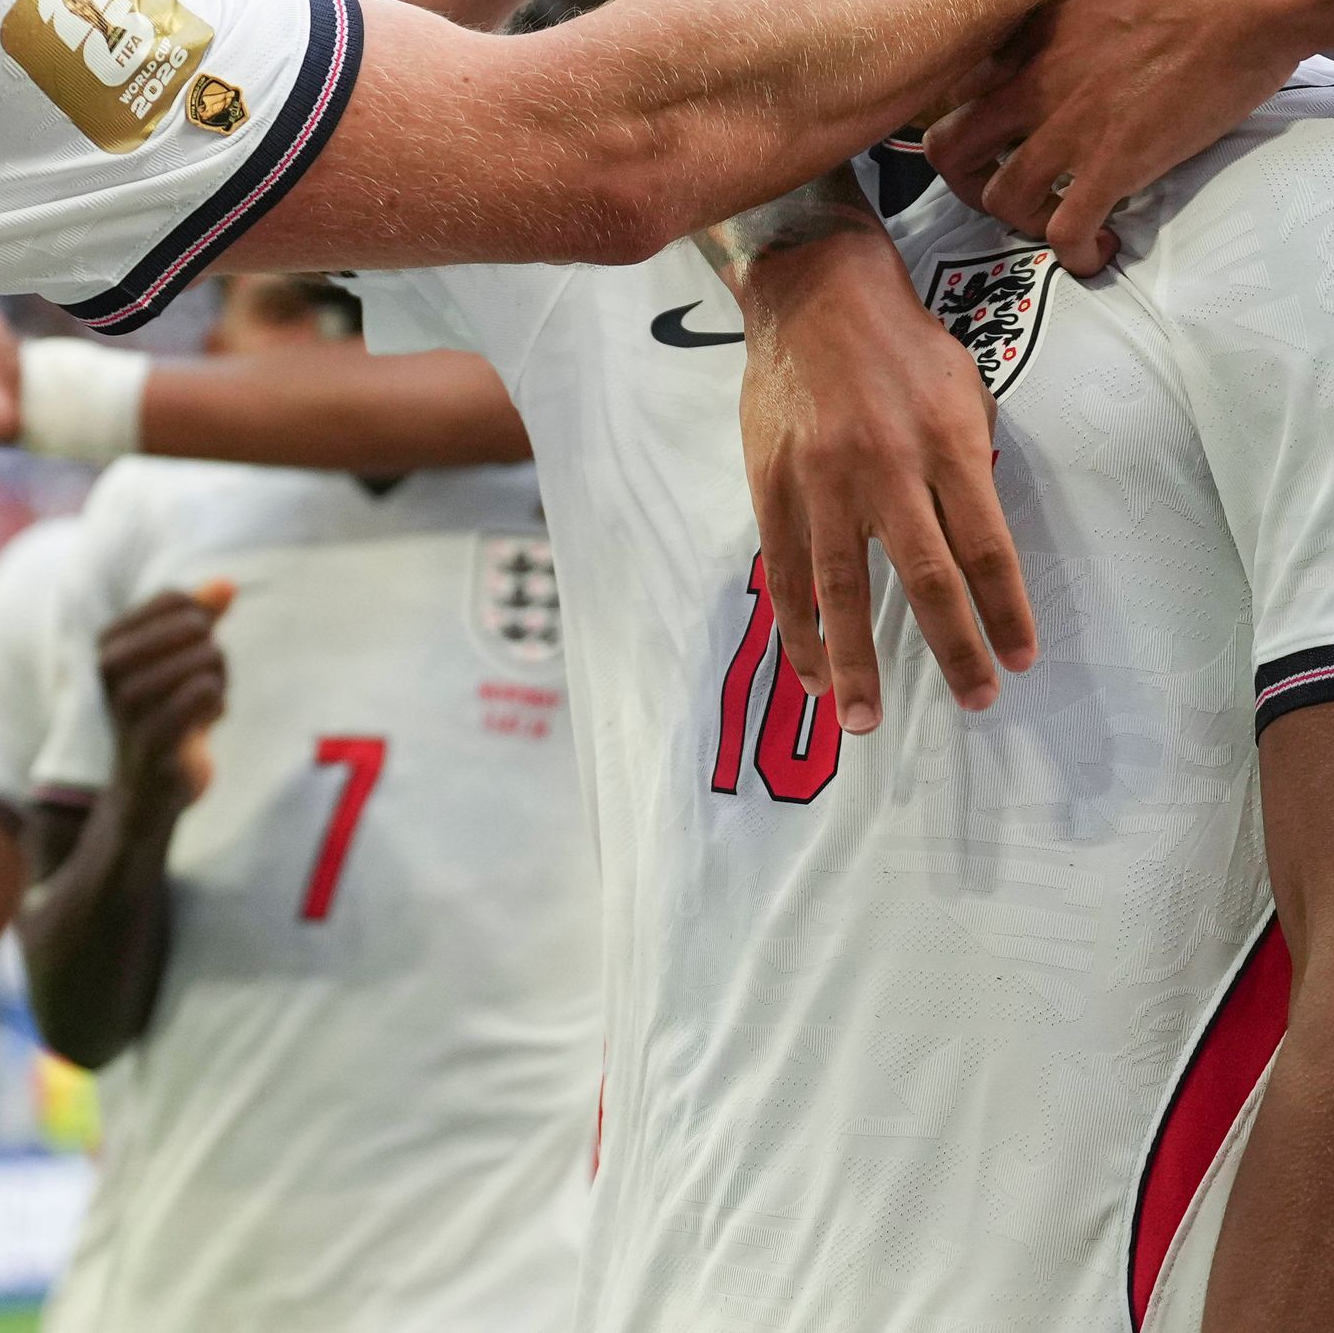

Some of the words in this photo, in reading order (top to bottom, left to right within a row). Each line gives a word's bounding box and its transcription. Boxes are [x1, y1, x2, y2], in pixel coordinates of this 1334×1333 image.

[115, 35, 143, 68] FIFA
[118, 60, 158, 105] WORLD
[154, 36, 172, 62] CUP
[130, 46, 188, 120] 2026
[301, 730, 388, 923] 7
